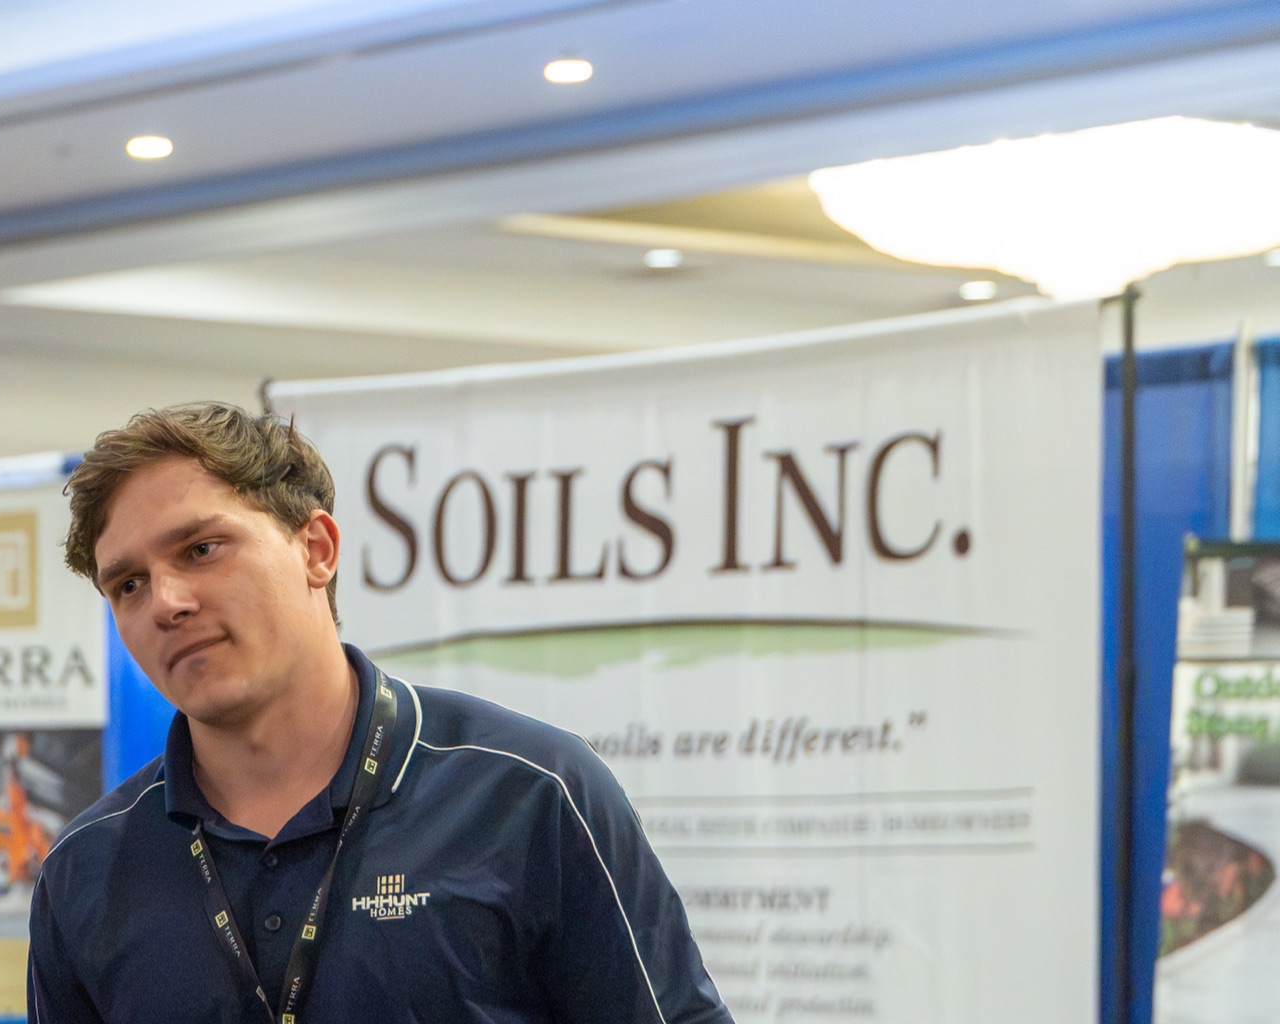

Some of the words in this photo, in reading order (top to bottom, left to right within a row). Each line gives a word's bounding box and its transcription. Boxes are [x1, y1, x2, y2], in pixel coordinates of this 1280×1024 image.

[361, 443, 675, 592] SOILS
[710, 414, 972, 575] INC.
[370, 725, 383, 757] TERRA
[674, 728, 729, 756] are
[198, 853, 212, 884] TERRA
[352, 892, 430, 911] HHHUNT
[370, 906, 412, 918] HOMES
[224, 925, 241, 958] TERRA
[286, 976, 302, 1011] TERRA
